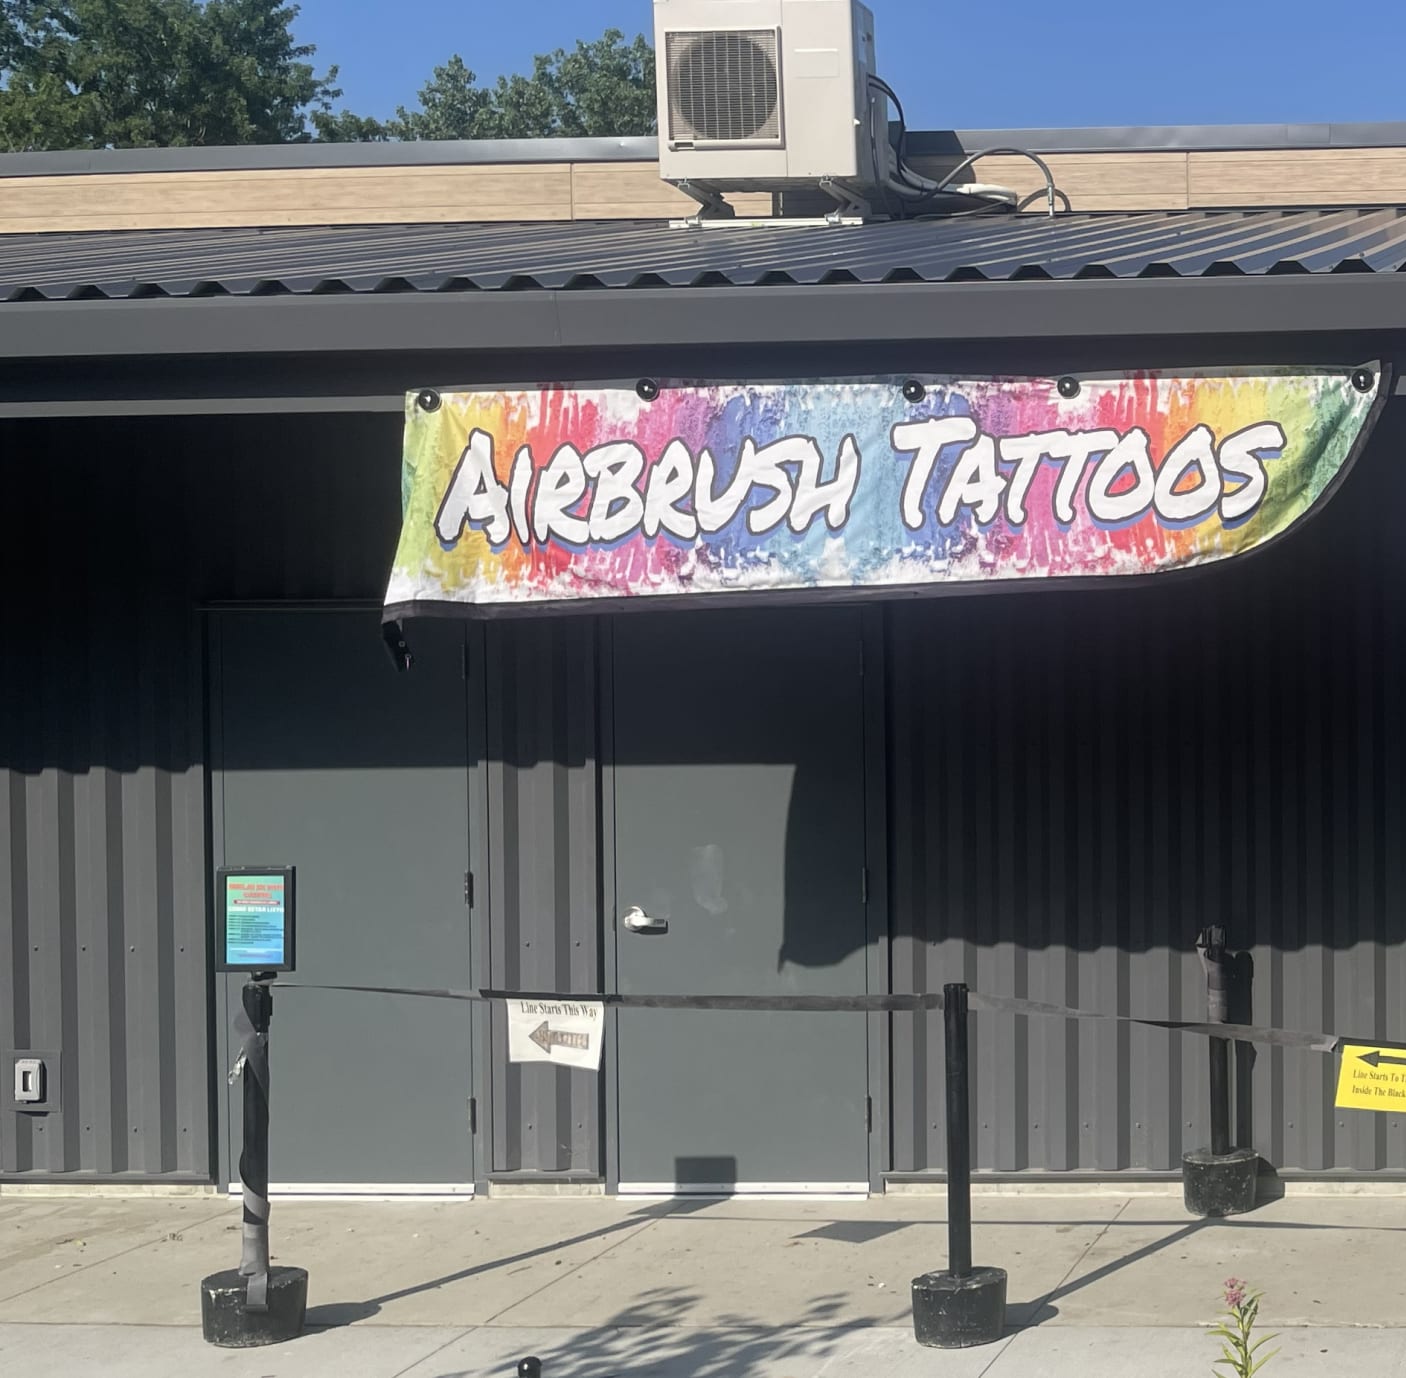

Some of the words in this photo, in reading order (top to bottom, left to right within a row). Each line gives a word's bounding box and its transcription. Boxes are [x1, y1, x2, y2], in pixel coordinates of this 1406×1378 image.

[435, 427, 861, 551] AIRBRUSH
[890, 417, 1287, 531] TATTOOS
[521, 1001, 538, 1014] Line
[539, 1002, 562, 1015] Starts
[562, 1003, 579, 1016] This
[580, 1005, 598, 1021] Way
[1353, 1069, 1367, 1079] Line
[1369, 1071, 1389, 1081] Starts
[1391, 1073, 1400, 1082] To
[1352, 1085, 1372, 1095] Inside
[1374, 1087, 1386, 1096] The
[1387, 1088, 1406, 1098] Black
